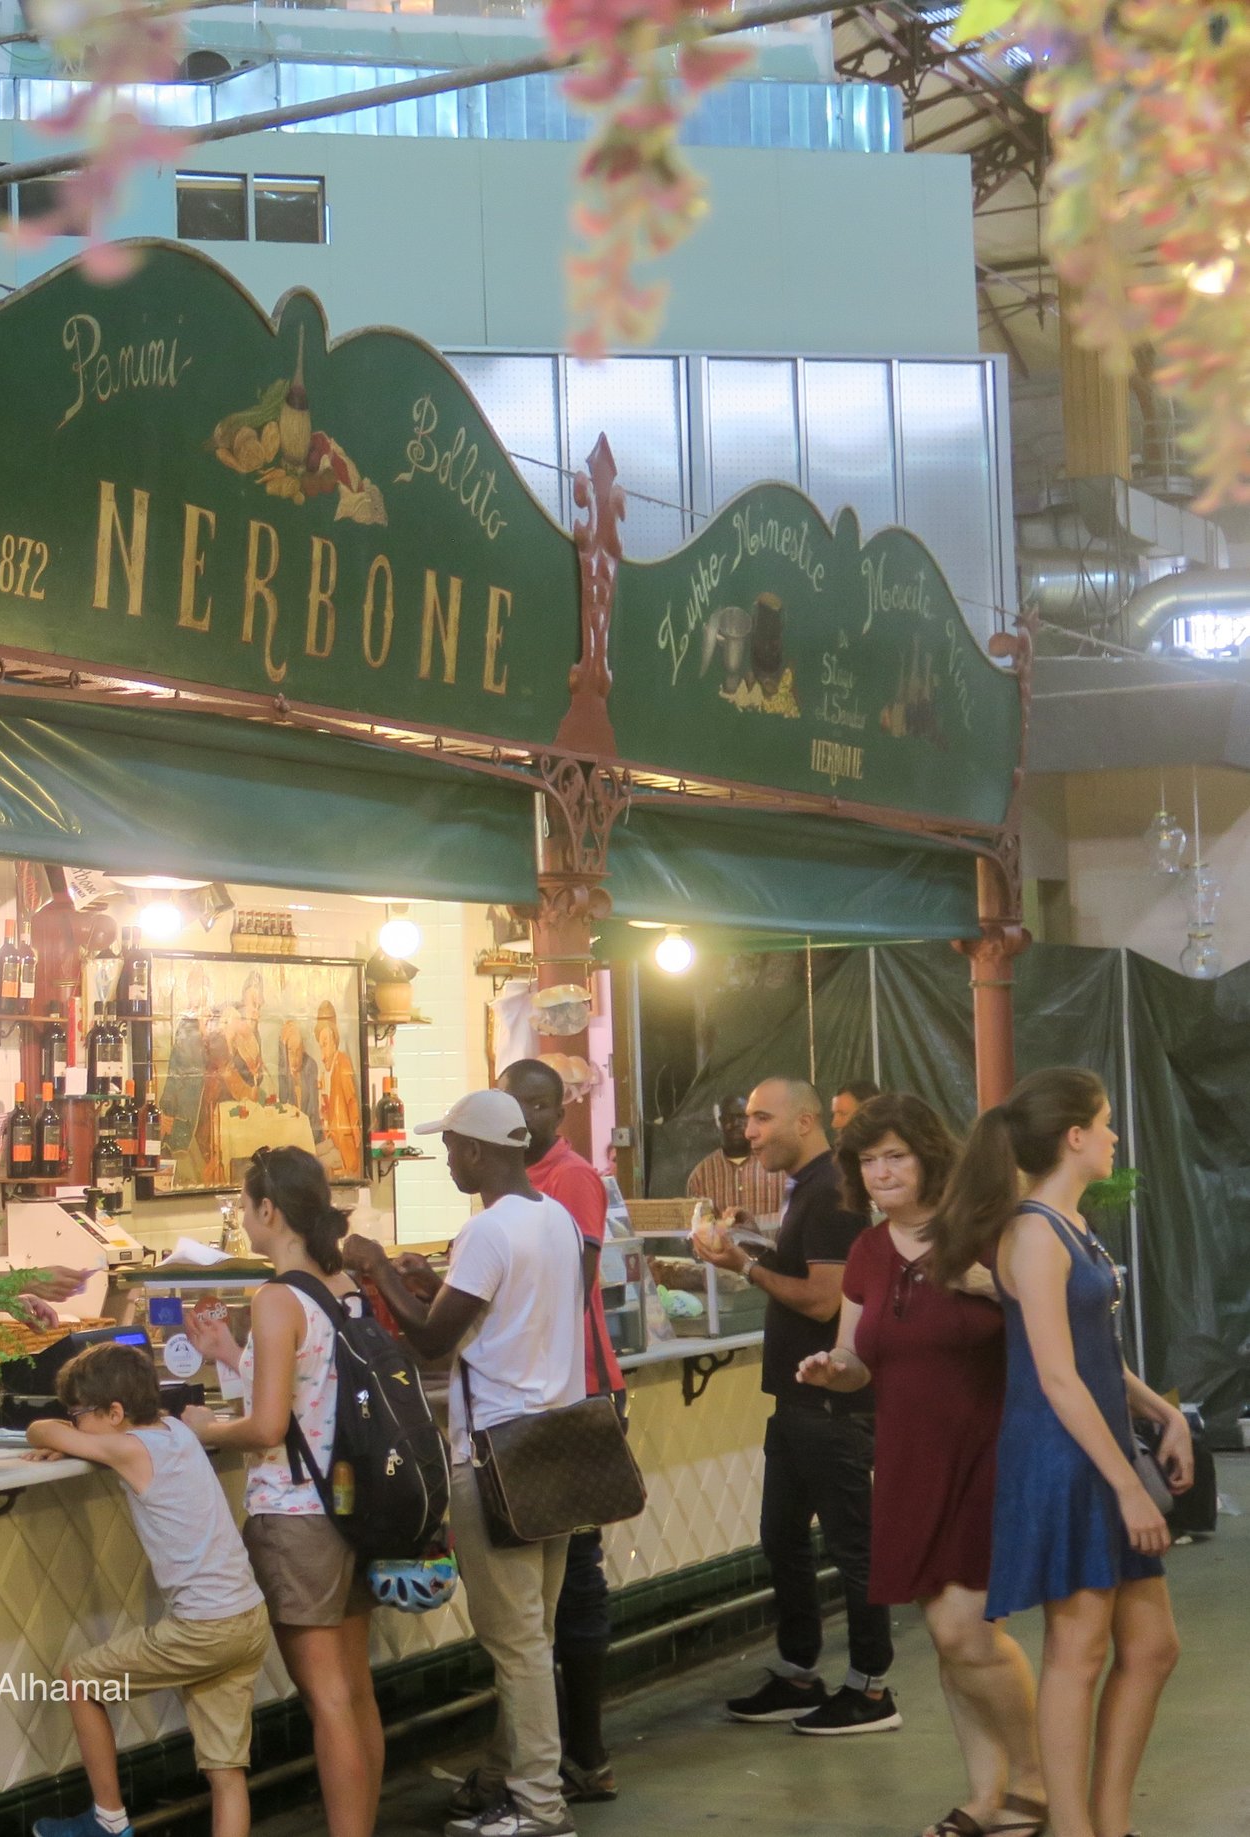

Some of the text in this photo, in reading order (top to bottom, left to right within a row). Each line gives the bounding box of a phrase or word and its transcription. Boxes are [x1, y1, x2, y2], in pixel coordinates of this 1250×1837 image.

[55, 313, 193, 430] Panini
[92, 480, 513, 695] NERBONE
[729, 504, 825, 592] Minestre
[658, 553, 727, 686] Zuppe
